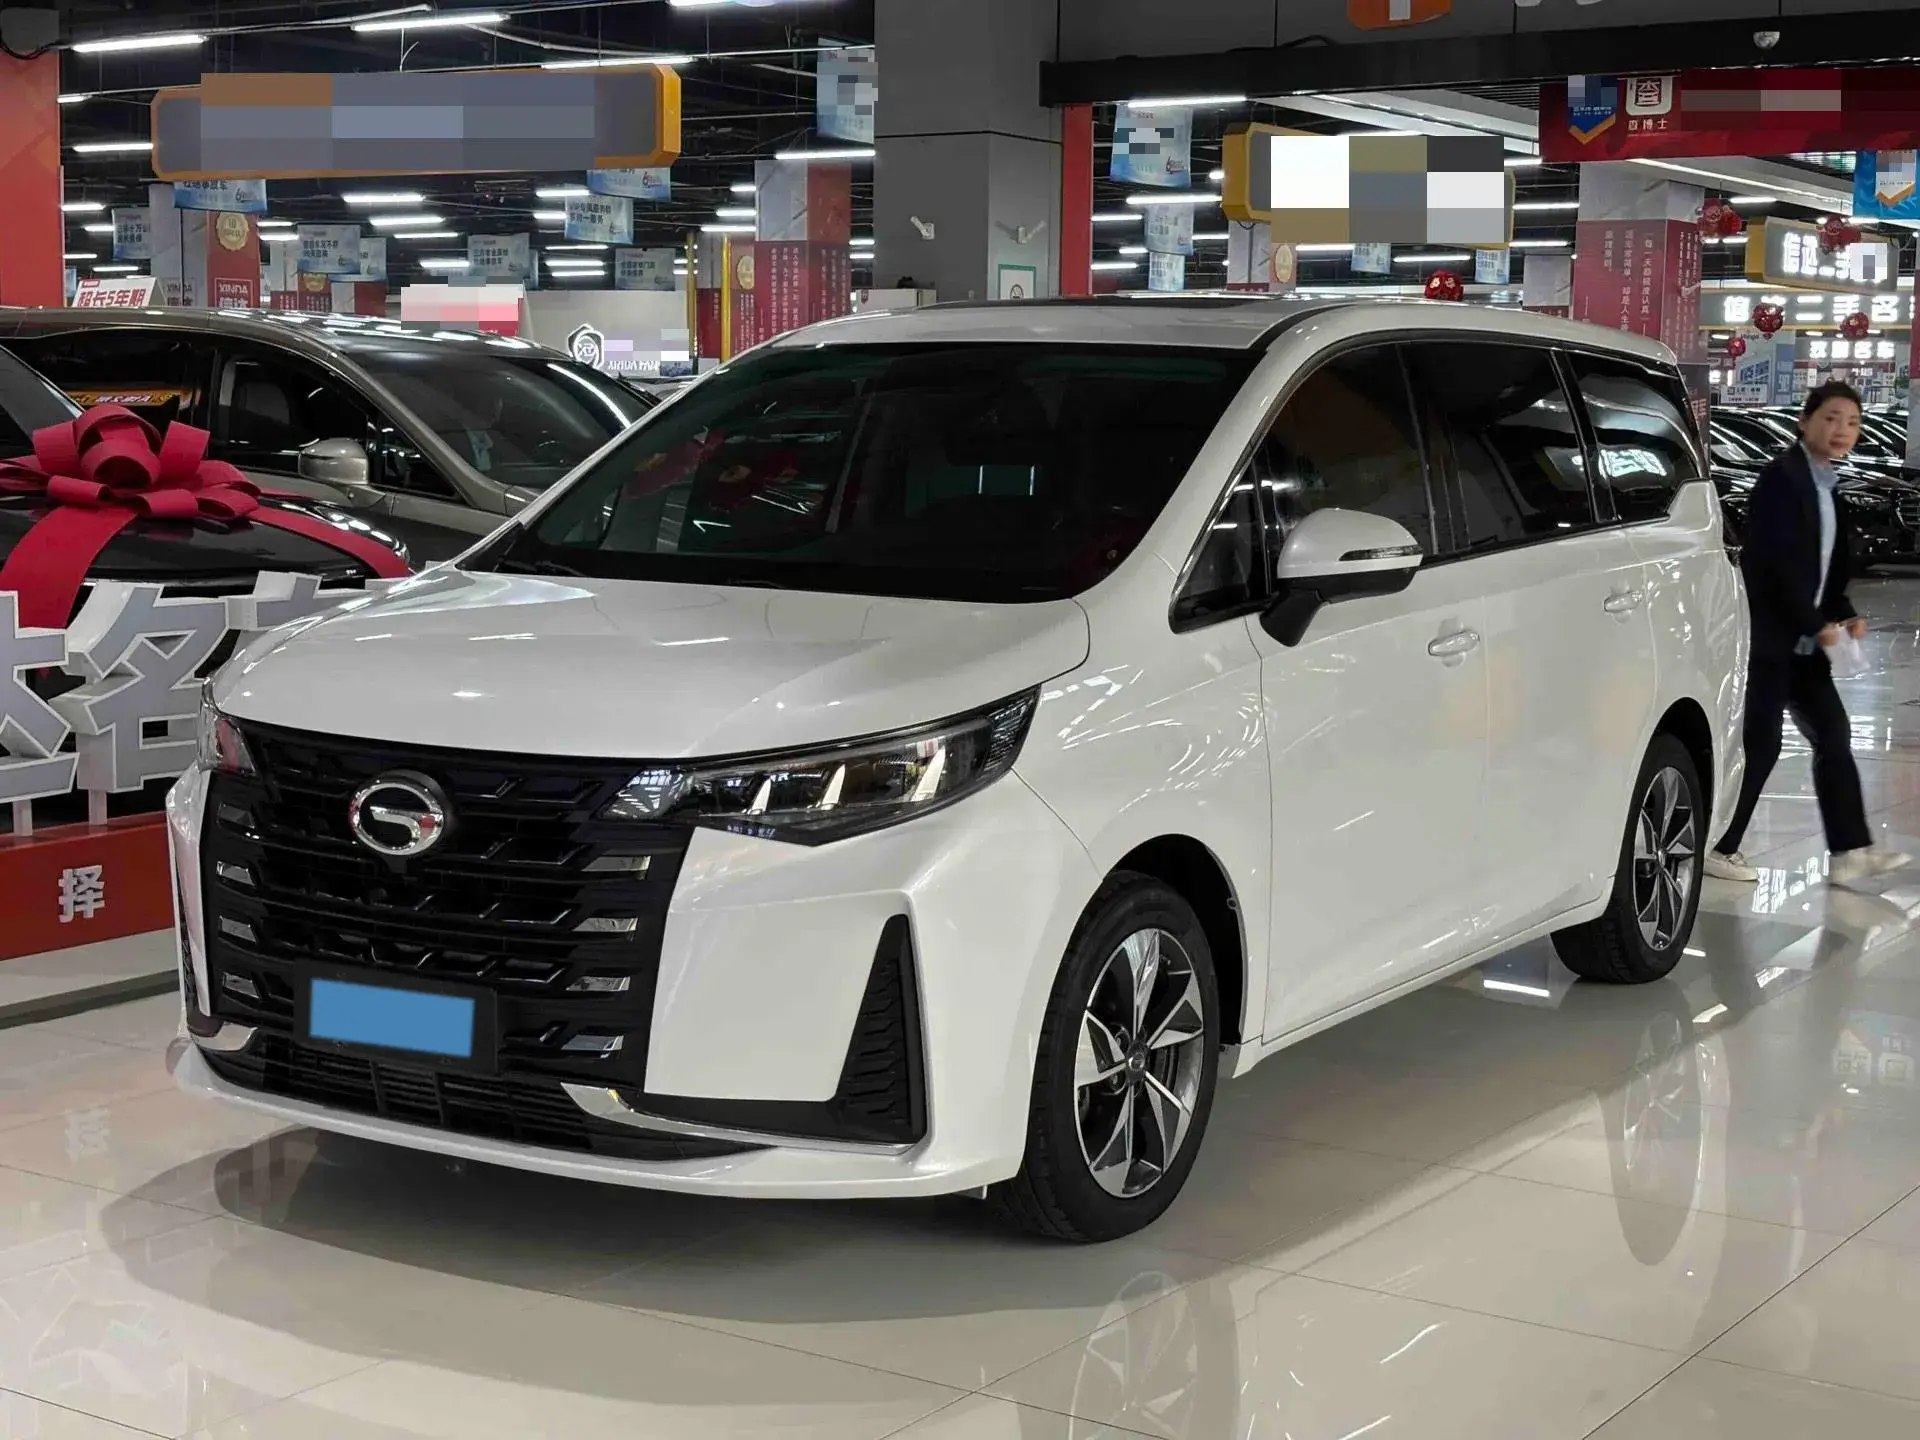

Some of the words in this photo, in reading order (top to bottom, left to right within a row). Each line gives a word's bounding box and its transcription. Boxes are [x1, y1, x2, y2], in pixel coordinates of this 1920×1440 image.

[1628, 118, 1669, 131] 查博士
[58, 866, 105, 923] 择
